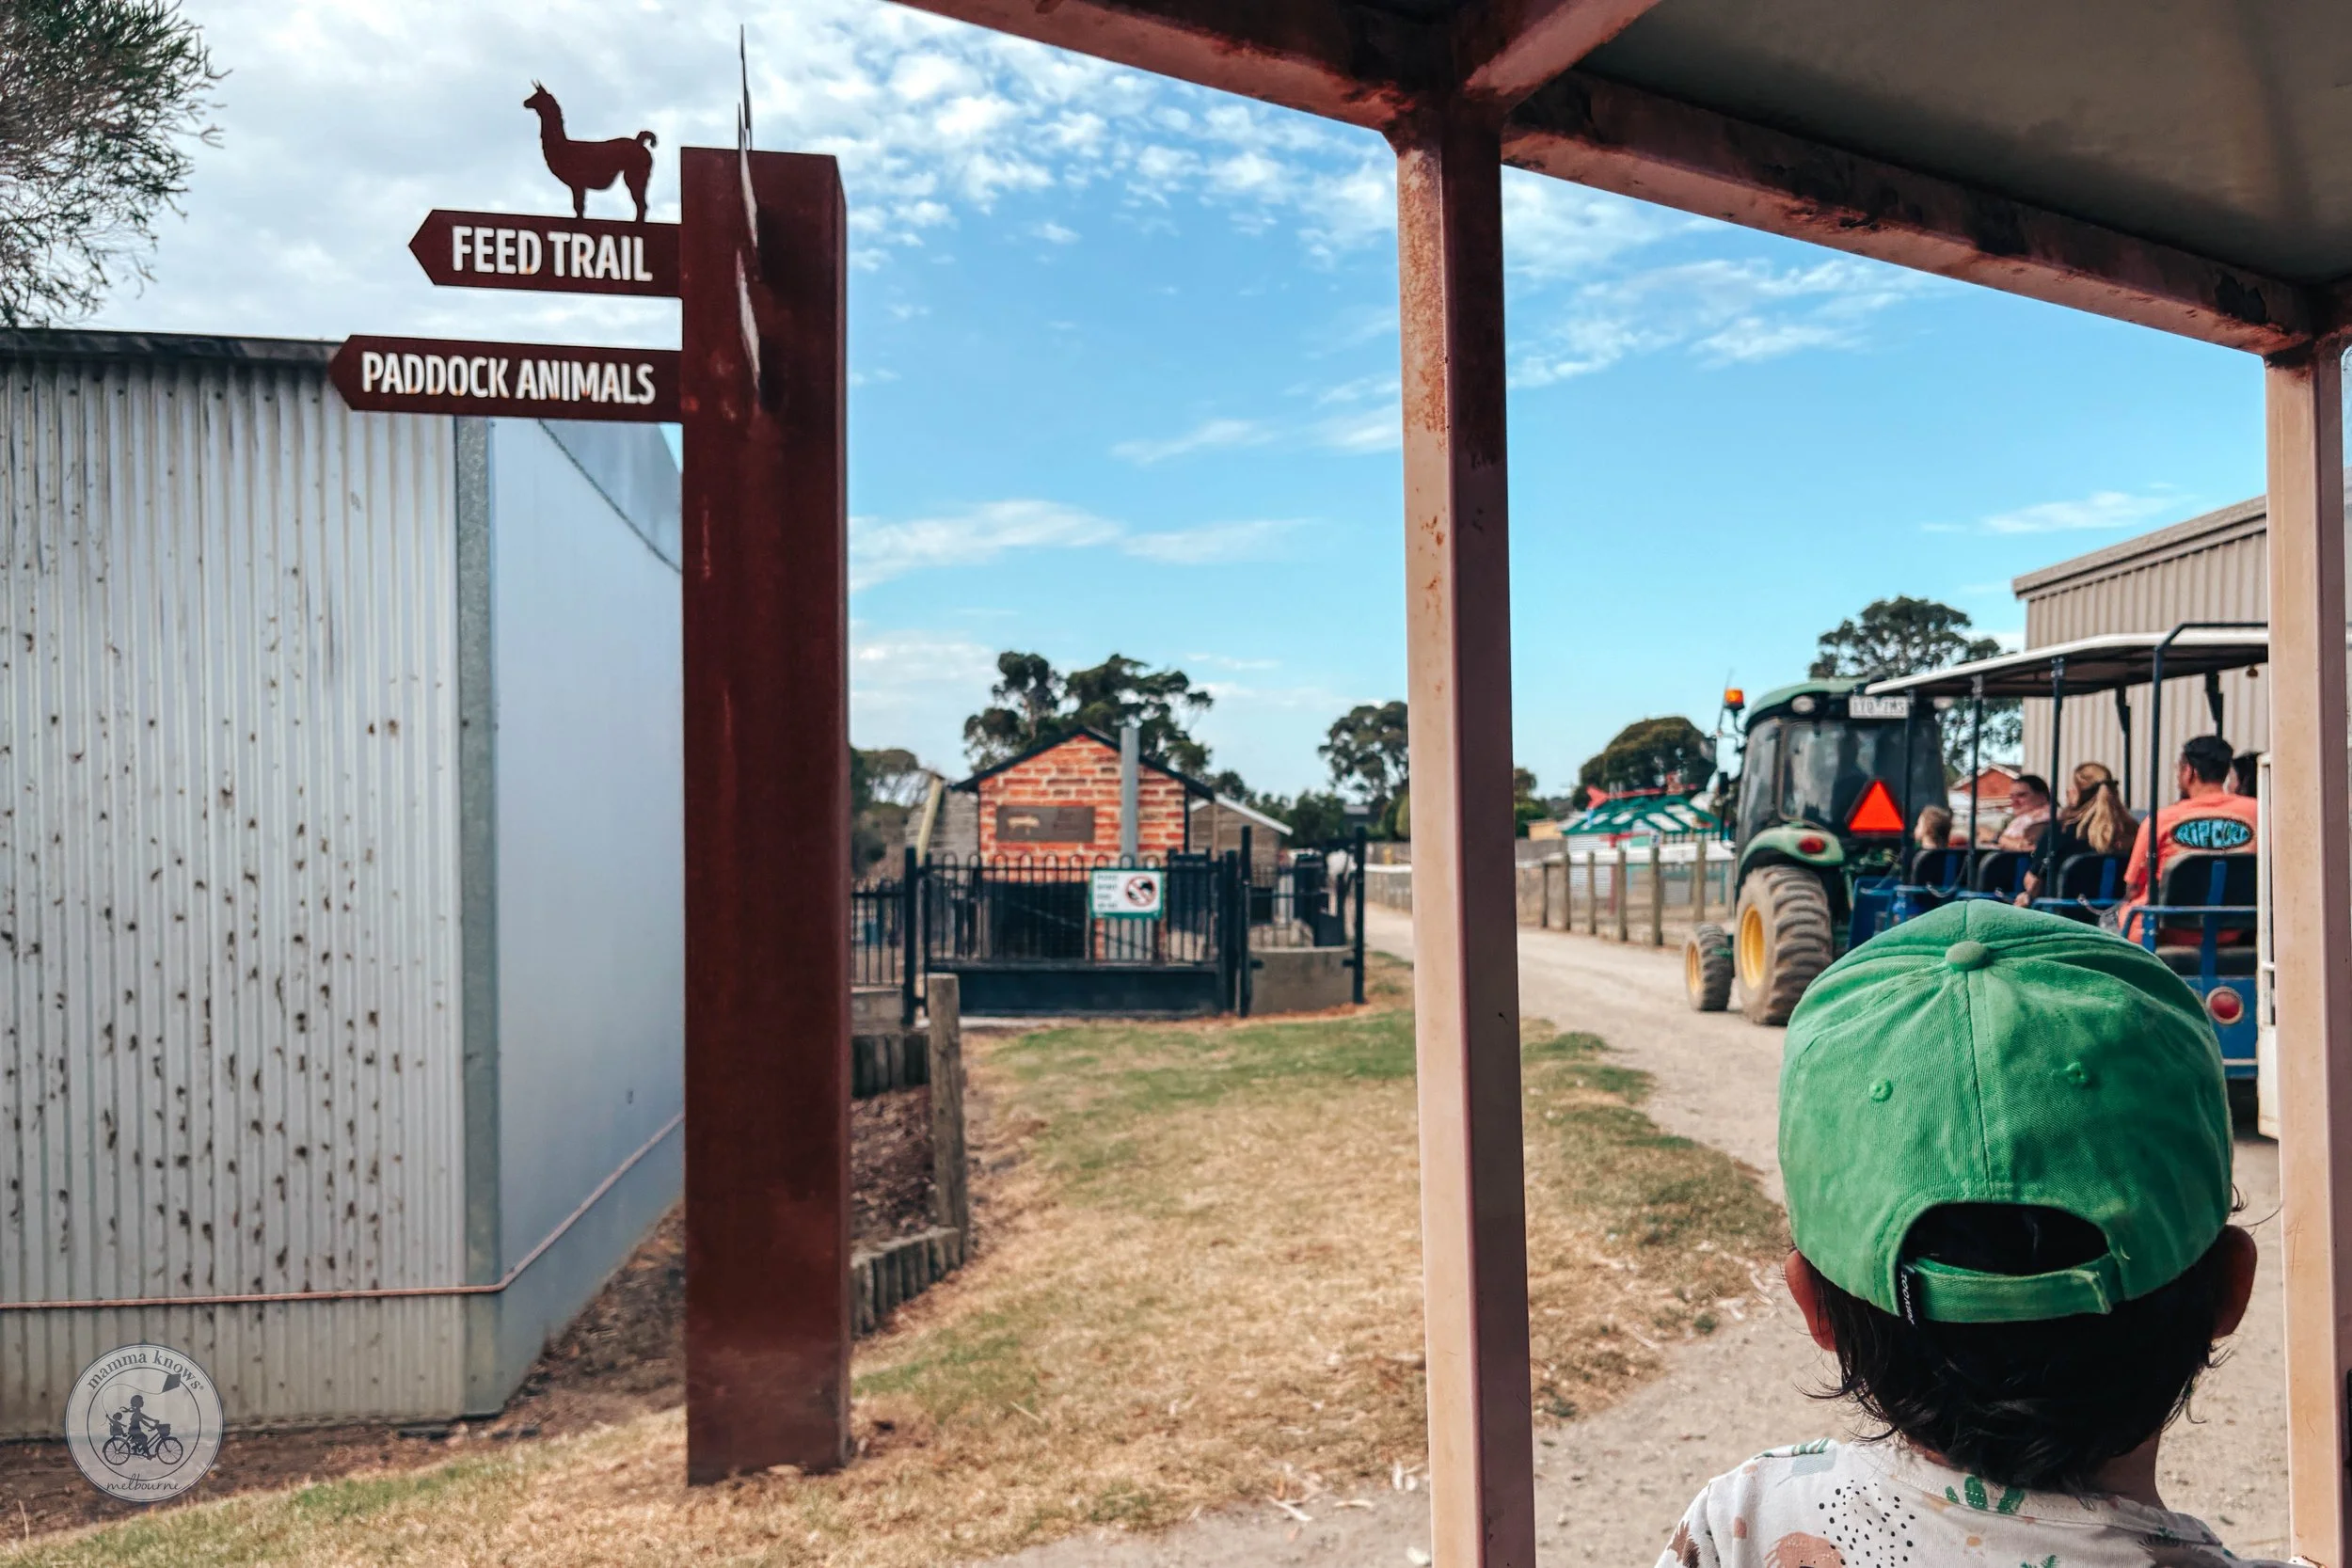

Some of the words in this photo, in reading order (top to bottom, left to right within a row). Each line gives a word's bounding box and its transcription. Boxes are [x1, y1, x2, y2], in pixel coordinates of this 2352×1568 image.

[452, 225, 543, 275] FEED
[548, 230, 653, 282] TRAIL
[361, 351, 510, 399] PADDOCK
[516, 357, 656, 404] ANIMALS
